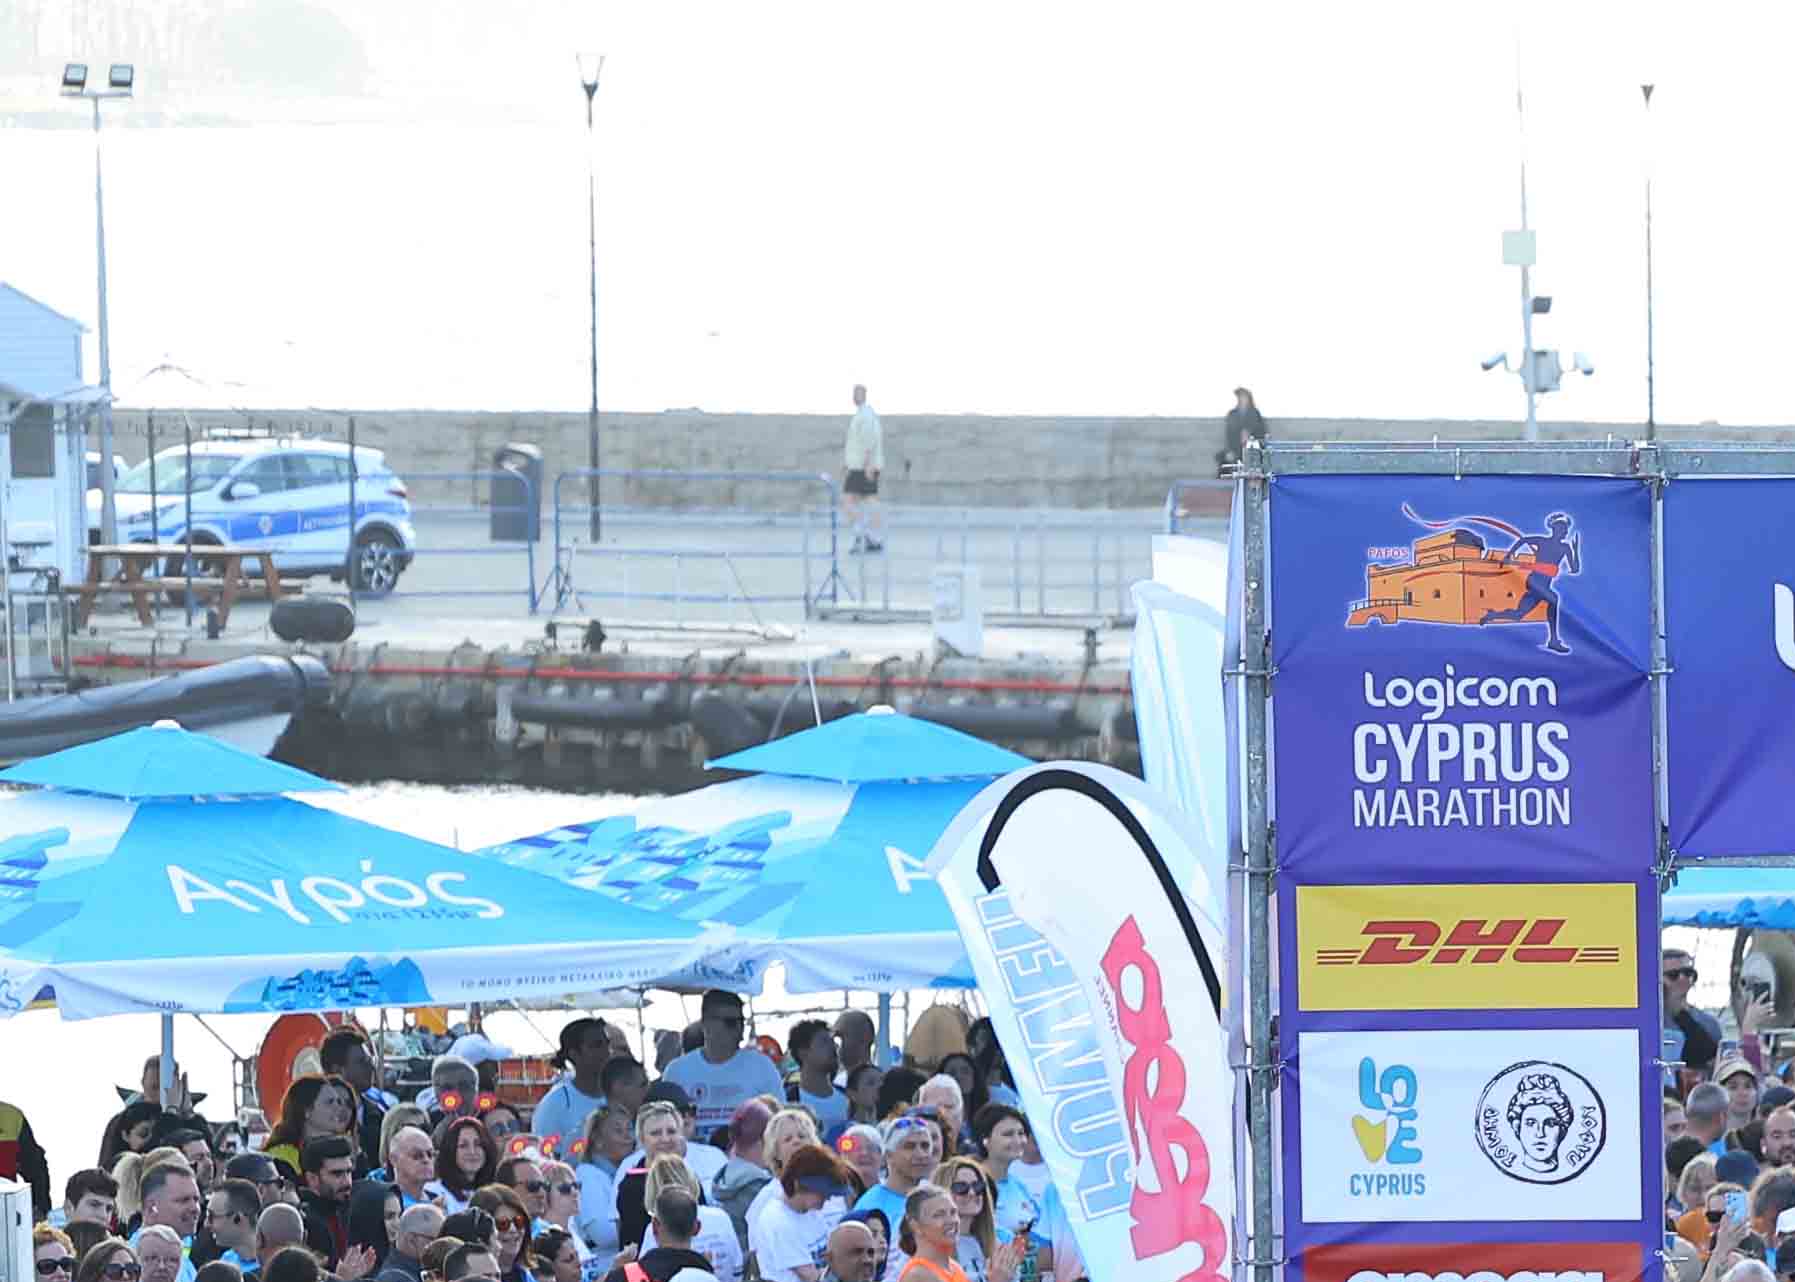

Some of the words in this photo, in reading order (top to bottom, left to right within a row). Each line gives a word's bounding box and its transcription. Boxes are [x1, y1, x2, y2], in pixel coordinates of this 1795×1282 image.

[1363, 664, 1557, 720] Logicom
[1352, 723, 1571, 785] CYPRUS
[1352, 787, 1571, 827] MARATHON
[1356, 919, 1577, 965] DHL
[1350, 1173, 1426, 1196] CYPRUS
